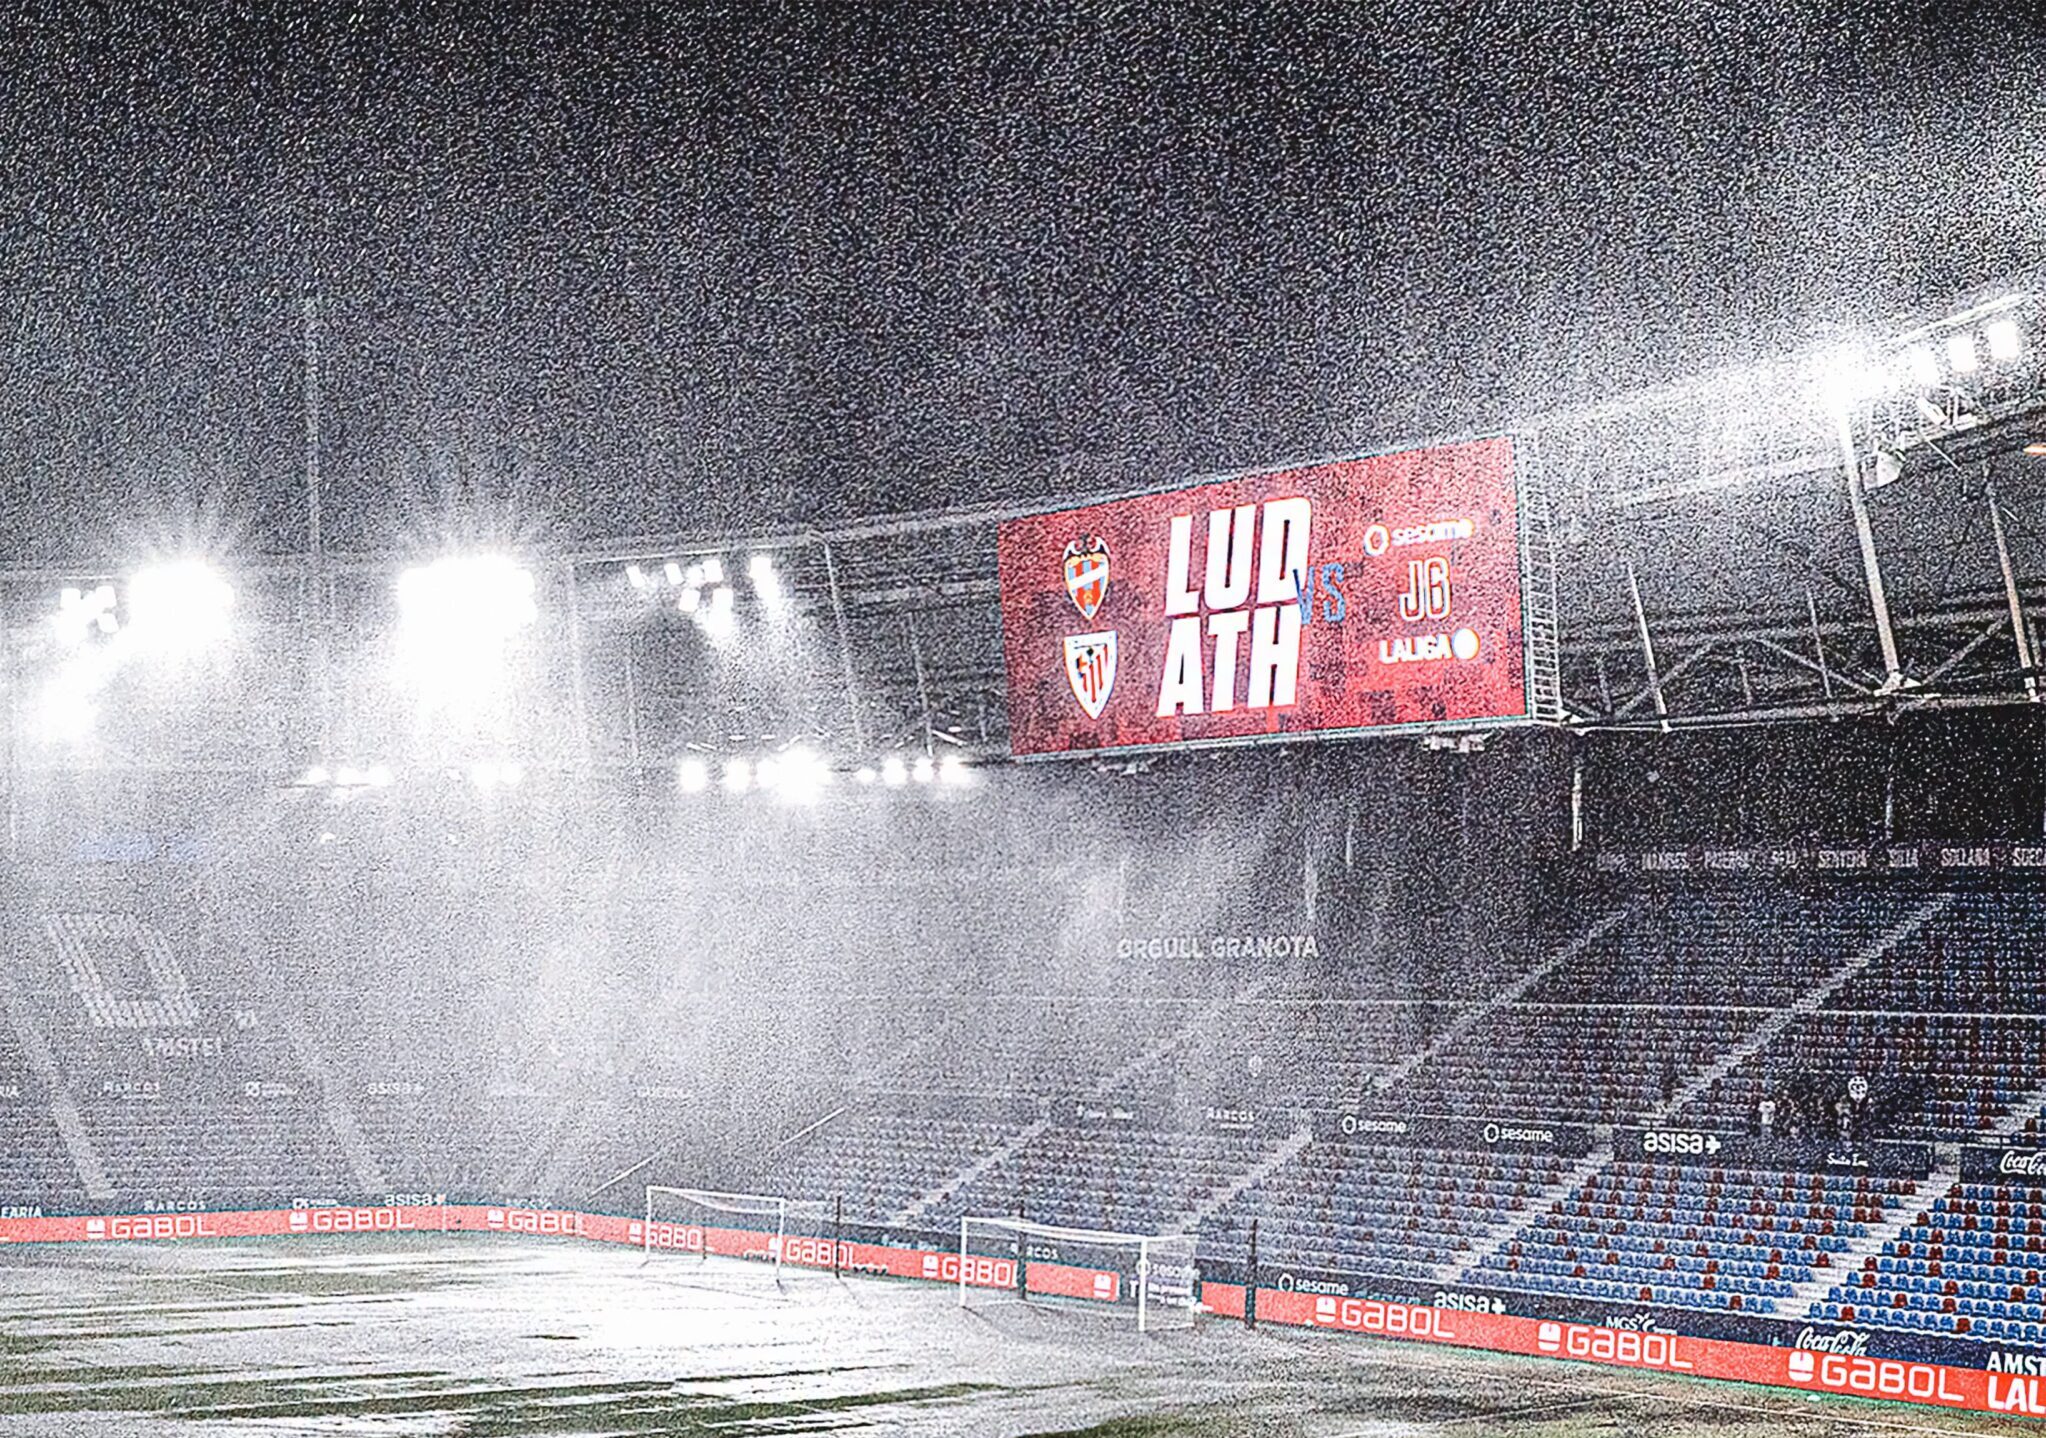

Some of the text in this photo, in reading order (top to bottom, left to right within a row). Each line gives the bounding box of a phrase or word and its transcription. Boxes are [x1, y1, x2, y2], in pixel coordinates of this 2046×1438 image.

[1392, 518, 1474, 546] sesame
[1164, 496, 1312, 617] LUD
[1293, 562, 1346, 626] VS
[1378, 633, 1453, 664] LALIGA
[1156, 606, 1302, 719] ATH
[1117, 935, 1320, 959] ORGULL GRANOTA
[1358, 1118, 1407, 1134] sesame
[1501, 1128, 1554, 1143] sesame
[1643, 1132, 1704, 1155] asisa
[384, 1192, 433, 1208] asisa
[1296, 1278, 1349, 1295] sesame
[1433, 1291, 1491, 1313] asisa
[1606, 1315, 1638, 1331] MGS
[1987, 1375, 2046, 1415] LAL
